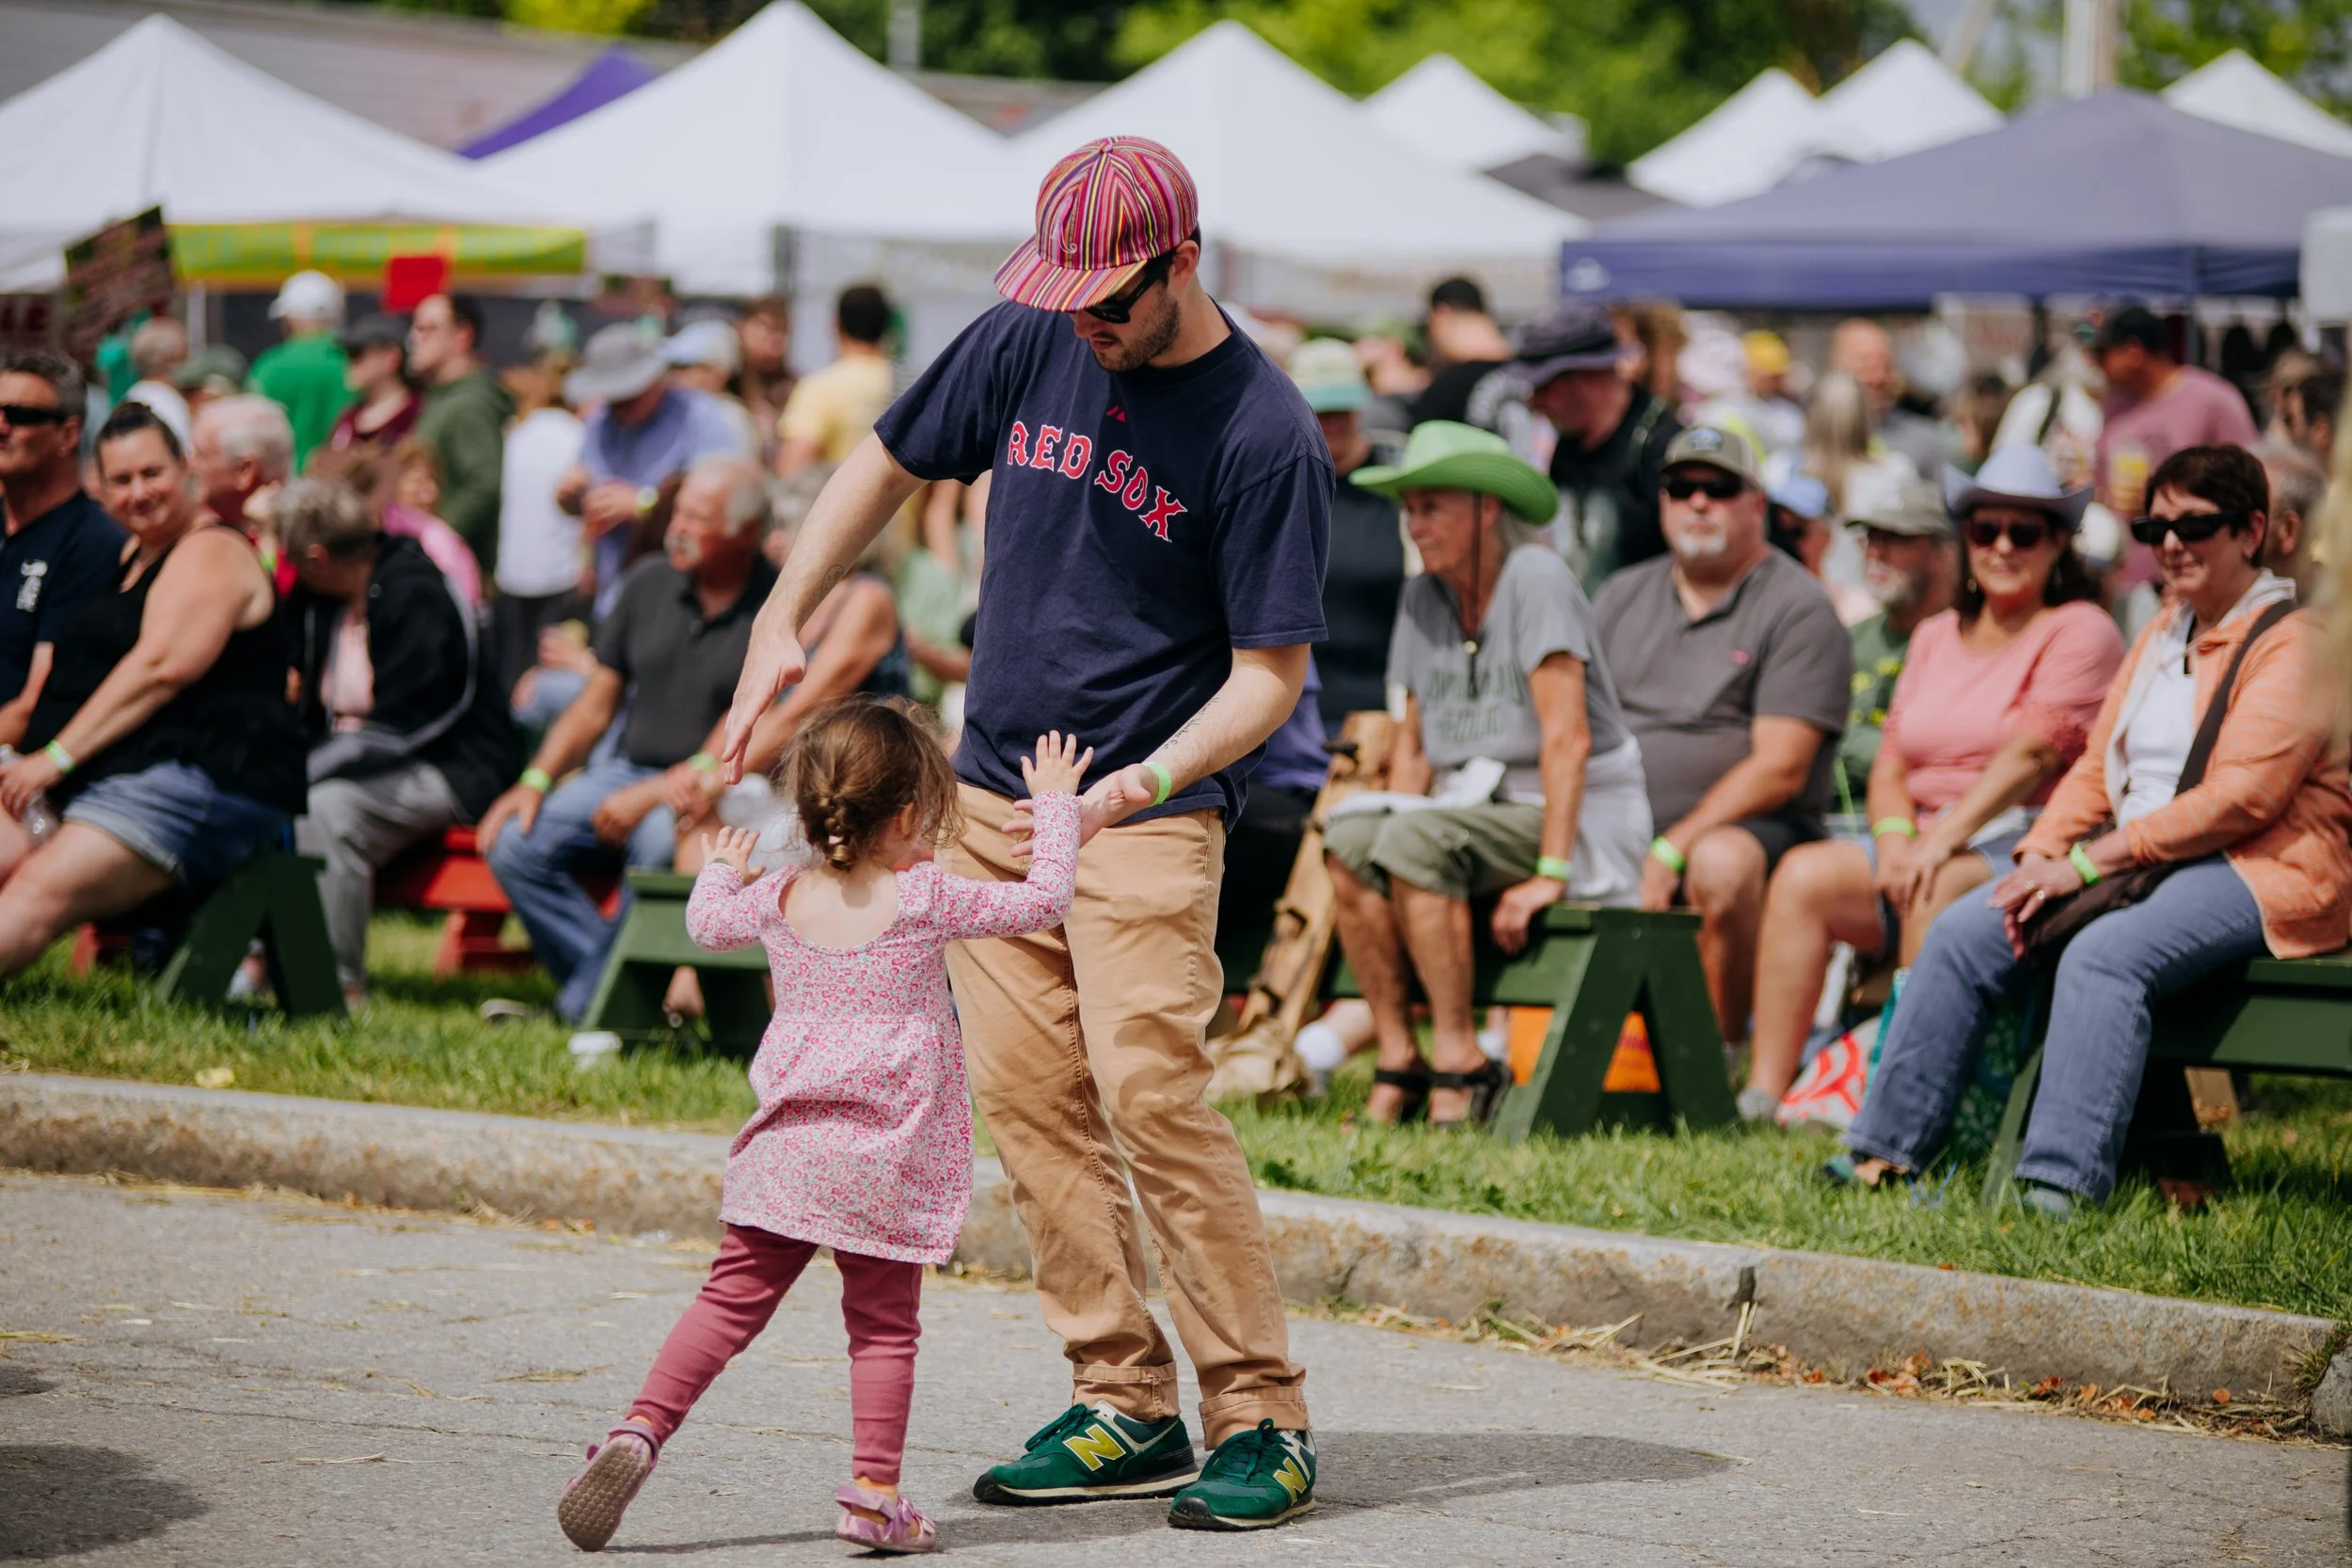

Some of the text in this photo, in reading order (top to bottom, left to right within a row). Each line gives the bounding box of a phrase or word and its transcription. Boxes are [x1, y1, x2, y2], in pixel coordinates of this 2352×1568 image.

[1007, 420, 1188, 543] RED SOX
[1063, 1423, 1126, 1471] N
[1273, 1456, 1307, 1506] N
